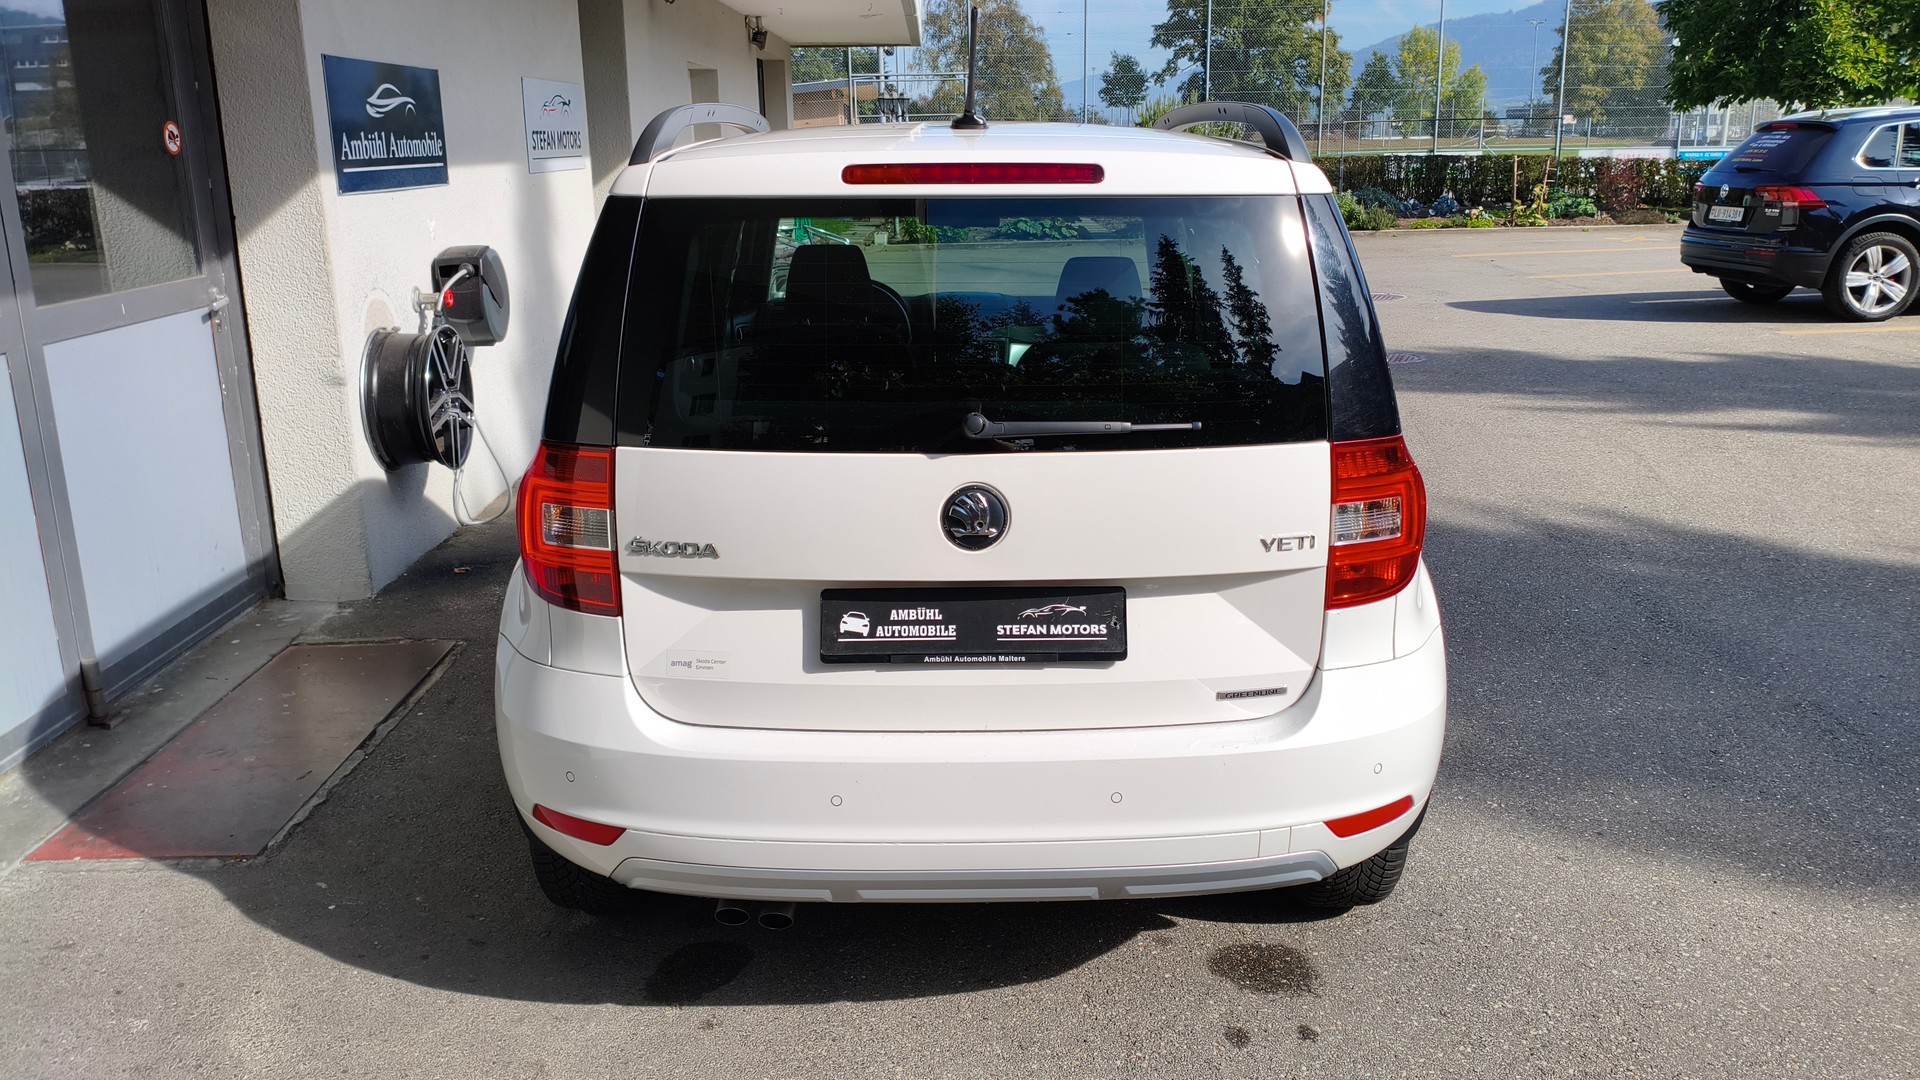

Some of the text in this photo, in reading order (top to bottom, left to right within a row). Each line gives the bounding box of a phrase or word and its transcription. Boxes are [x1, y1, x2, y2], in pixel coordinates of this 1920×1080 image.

[341, 131, 443, 160] Ambühl Automobile
[531, 130, 582, 151] STEFAN MOTORS
[1260, 534, 1316, 553] YETI
[889, 607, 943, 621] AMBÜHL
[875, 624, 957, 637] AUTOMOBILE
[996, 623, 1108, 635] STEFAN MOTORS
[670, 660, 693, 669] amag
[923, 655, 953, 663] Ambühl
[954, 655, 997, 663] Automobile
[1225, 688, 1281, 700] GREENLINE
